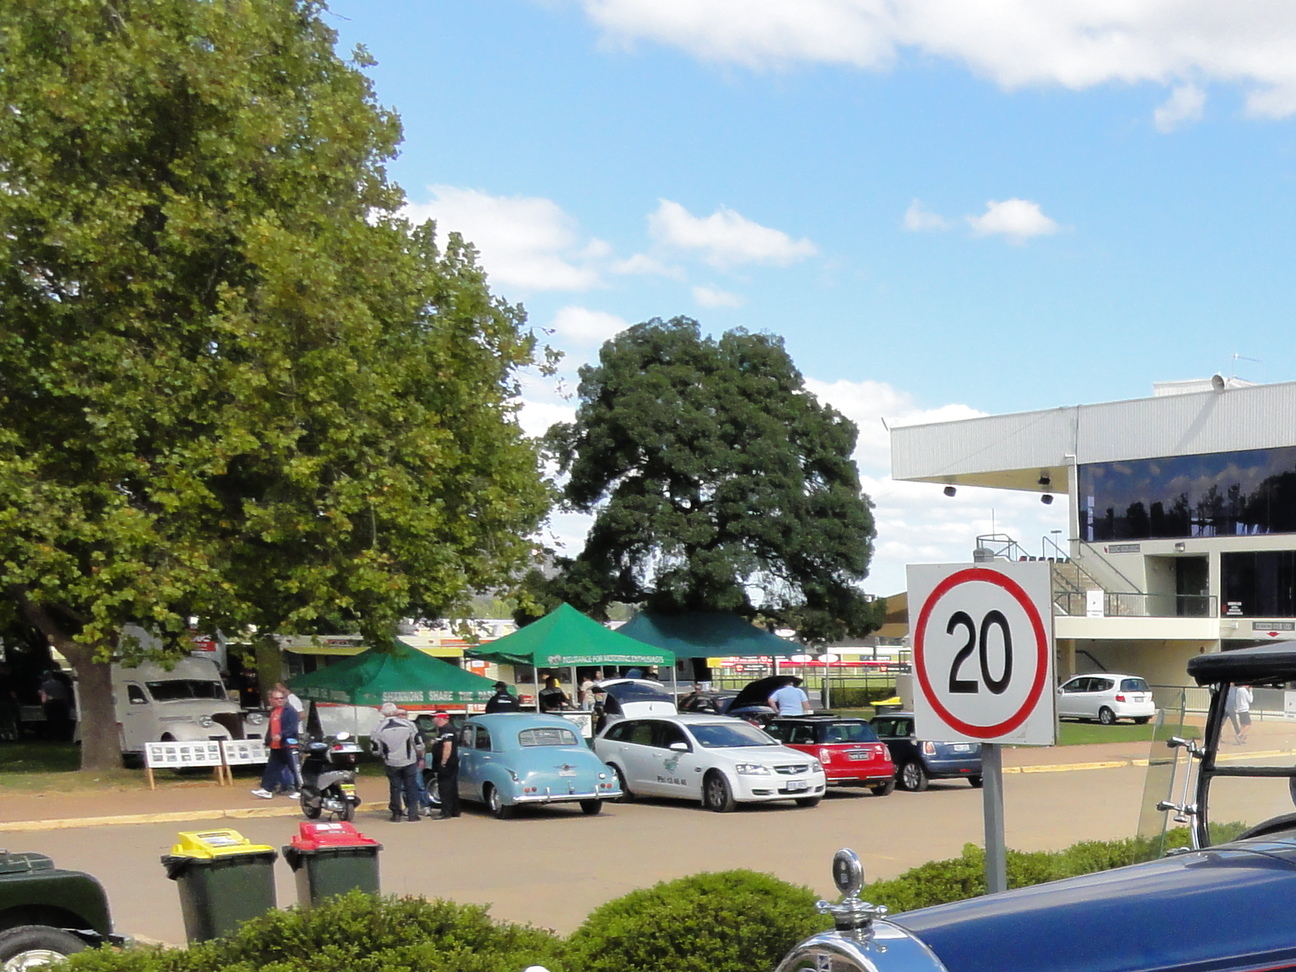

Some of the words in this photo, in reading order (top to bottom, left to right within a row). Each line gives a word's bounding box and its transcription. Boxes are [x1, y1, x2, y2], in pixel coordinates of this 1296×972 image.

[946, 609, 1013, 695] 20
[382, 691, 424, 702] SHANNONS
[428, 690, 453, 701] SHARE
[458, 691, 474, 701] THE
